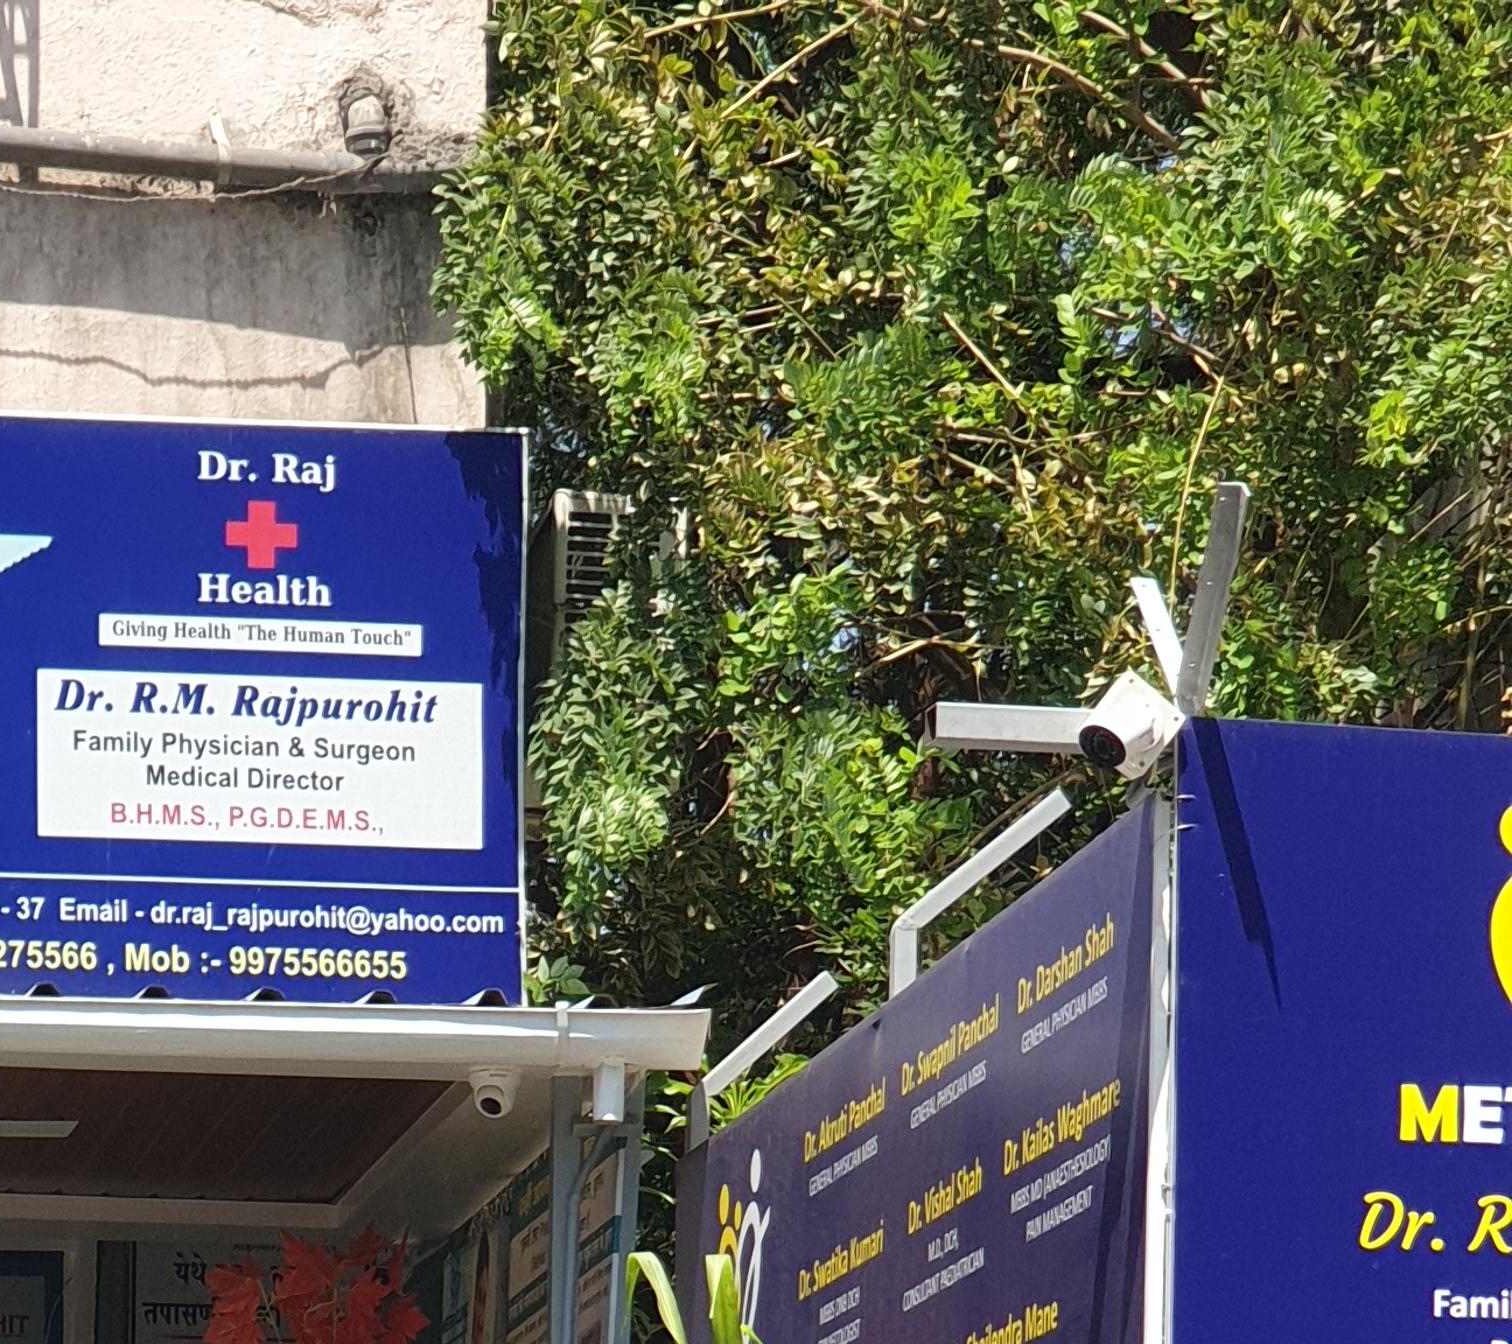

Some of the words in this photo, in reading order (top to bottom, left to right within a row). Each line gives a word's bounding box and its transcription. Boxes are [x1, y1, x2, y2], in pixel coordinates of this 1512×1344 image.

[197, 450, 257, 482] Dr.
[271, 453, 335, 493] Raj
[198, 573, 332, 607] Health
[112, 619, 168, 642] Giving
[174, 622, 231, 640] Health
[237, 623, 277, 642] "The
[283, 625, 345, 644] Human
[350, 628, 411, 646] Touch"
[54, 679, 113, 712] Dr.
[129, 681, 215, 716] R.M.
[231, 685, 438, 727] Rajpurohit
[73, 729, 153, 759] Family
[162, 732, 280, 761] Physician
[313, 737, 415, 766] Surgeon
[146, 764, 238, 788] Medical
[247, 767, 345, 791] Director
[111, 802, 220, 830] B.H.M.S.,
[229, 805, 383, 836] P.G.D.E.M.S.,
[16, 896, 45, 920] 37
[59, 897, 128, 923] Email
[150, 900, 504, 936] dr.raj_rajpurohit@yahoo.com
[125, 942, 190, 973] Mob
[229, 945, 407, 980] 9975566655
[1084, 913, 1114, 969] Shah
[958, 993, 999, 1058] Panchal
[1057, 1079, 1121, 1143] Waghmare
[1359, 1191, 1444, 1251] Dr.
